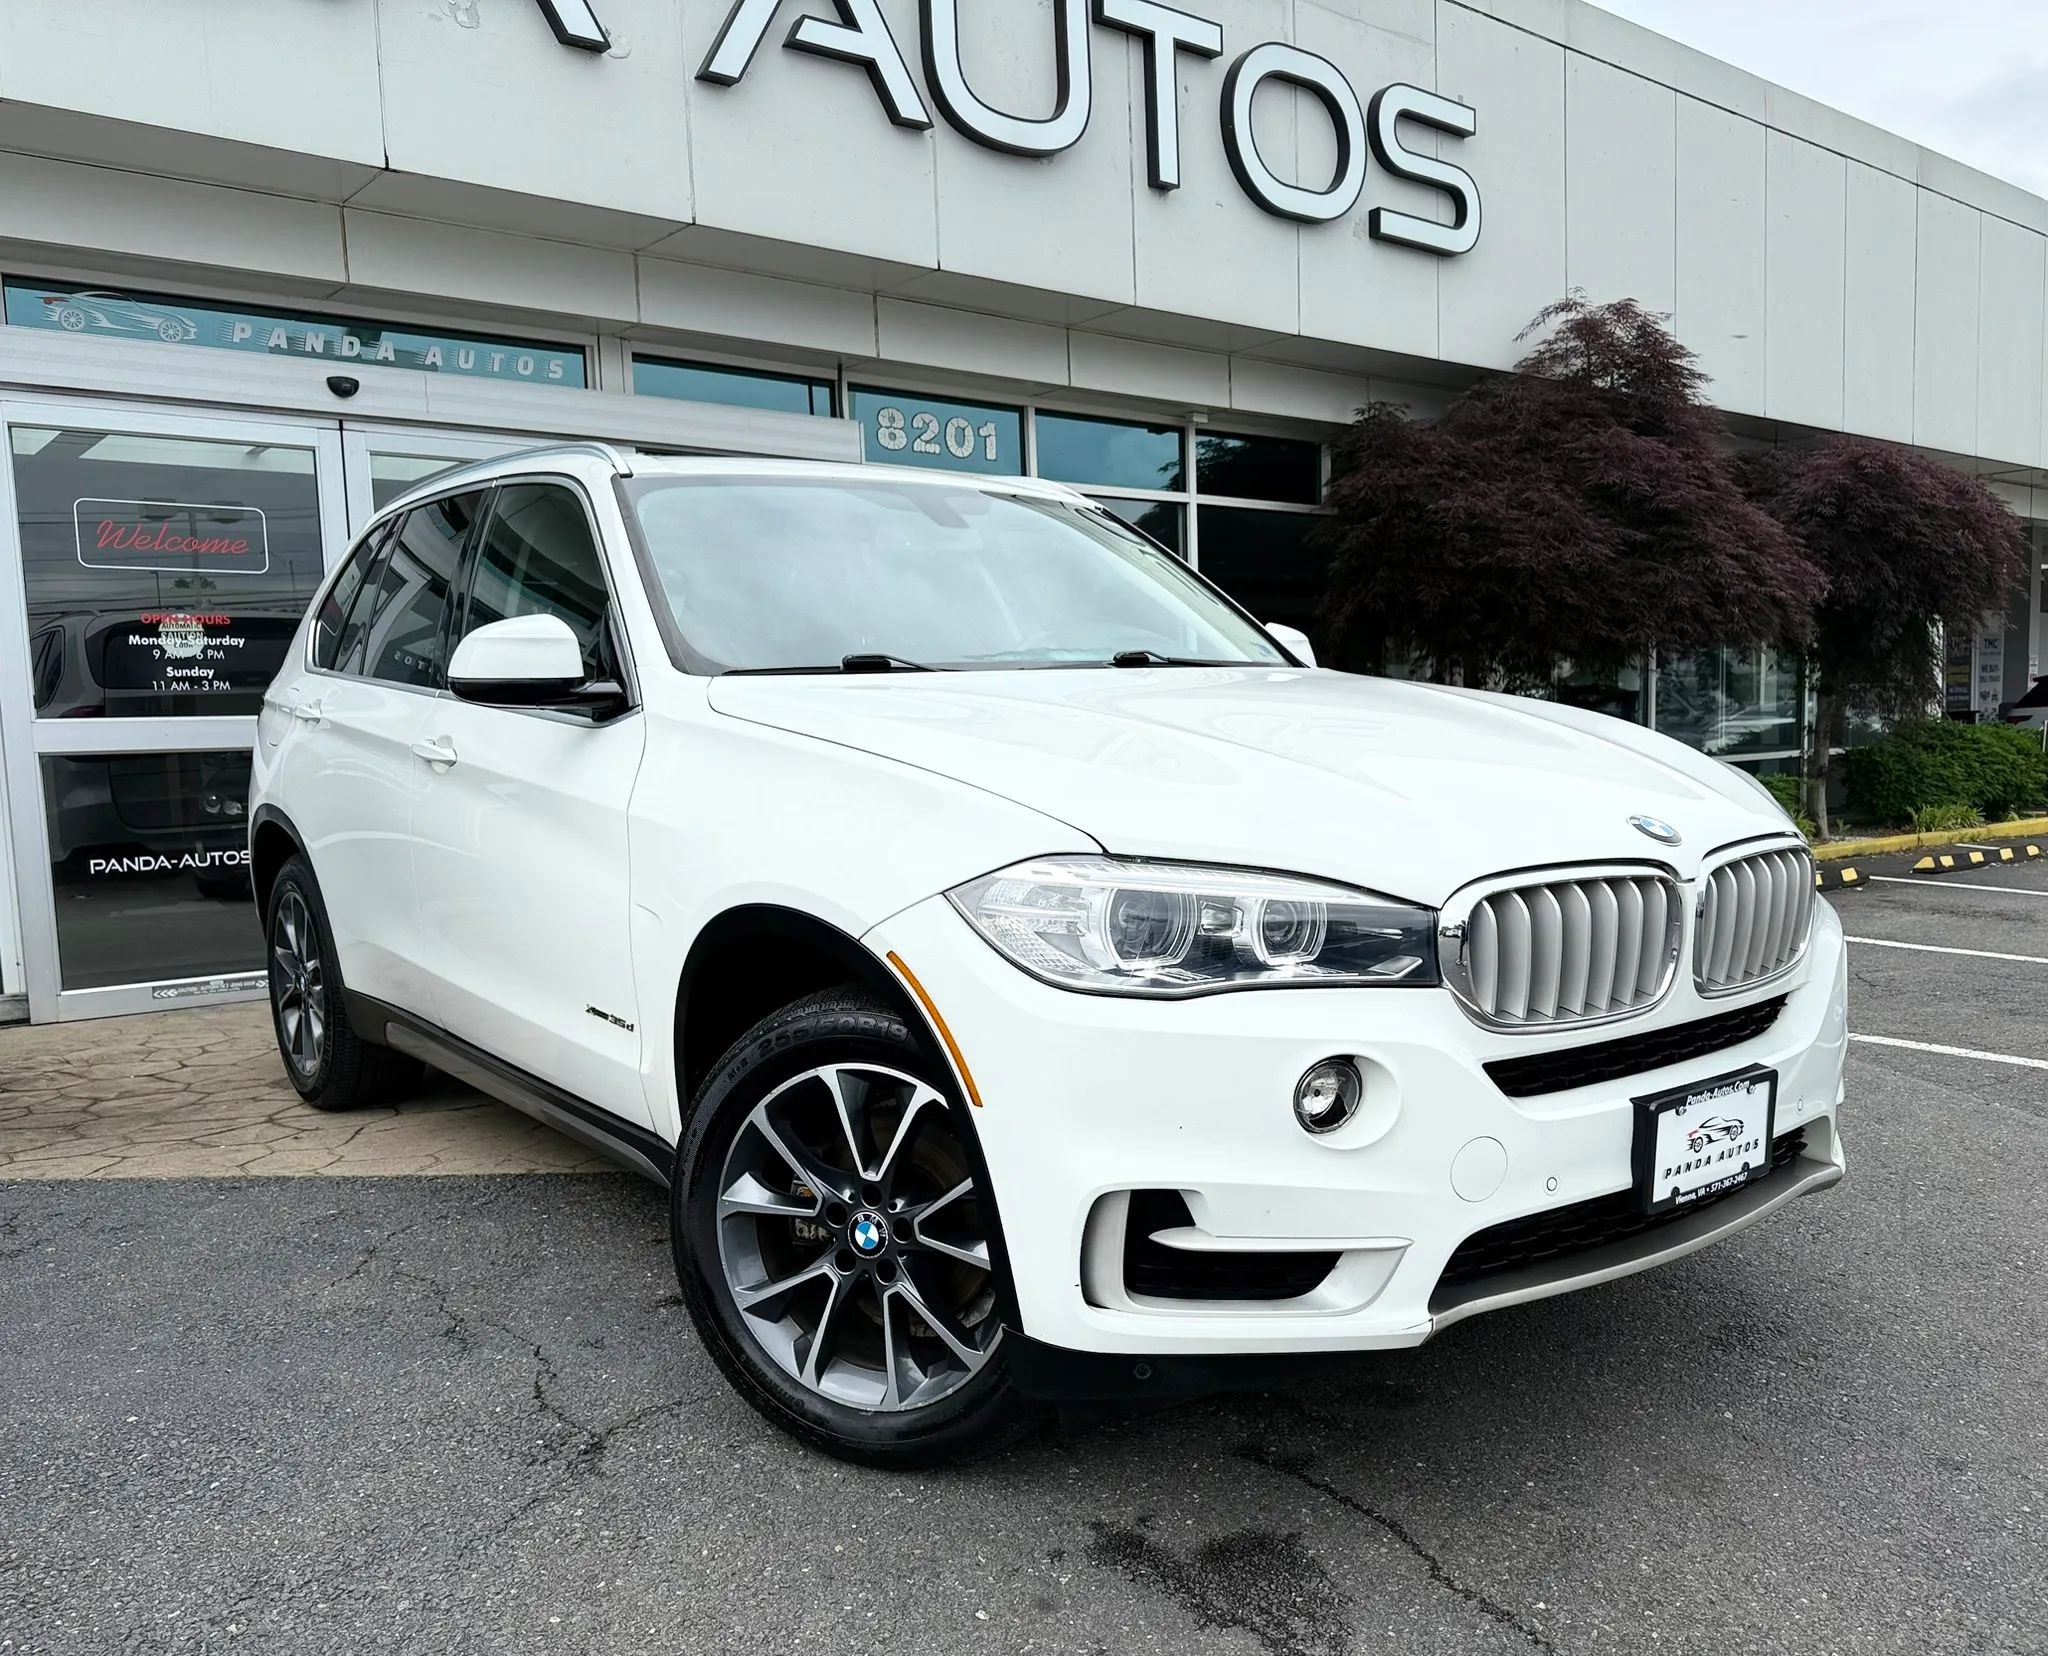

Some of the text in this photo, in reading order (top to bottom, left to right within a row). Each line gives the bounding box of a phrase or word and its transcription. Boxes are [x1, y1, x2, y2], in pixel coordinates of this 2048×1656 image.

[230, 321, 564, 380] PANDA AUTOS
[876, 406, 998, 462] 8201
[96, 519, 249, 554] Welcome
[140, 614, 231, 626] OPEN HOURS
[128, 634, 246, 649] Monday-Saturday
[152, 649, 225, 660] 9 AM 6 PM
[166, 666, 215, 679] Sunday
[152, 680, 166, 692] 11
[170, 680, 191, 692] AM
[201, 680, 210, 692] 3
[213, 680, 231, 692] PM
[89, 850, 250, 875] PANDA-AUTOS
[1663, 1138, 1760, 1180] PANDA AUTOS
[857, 1214, 887, 1237] BMW
